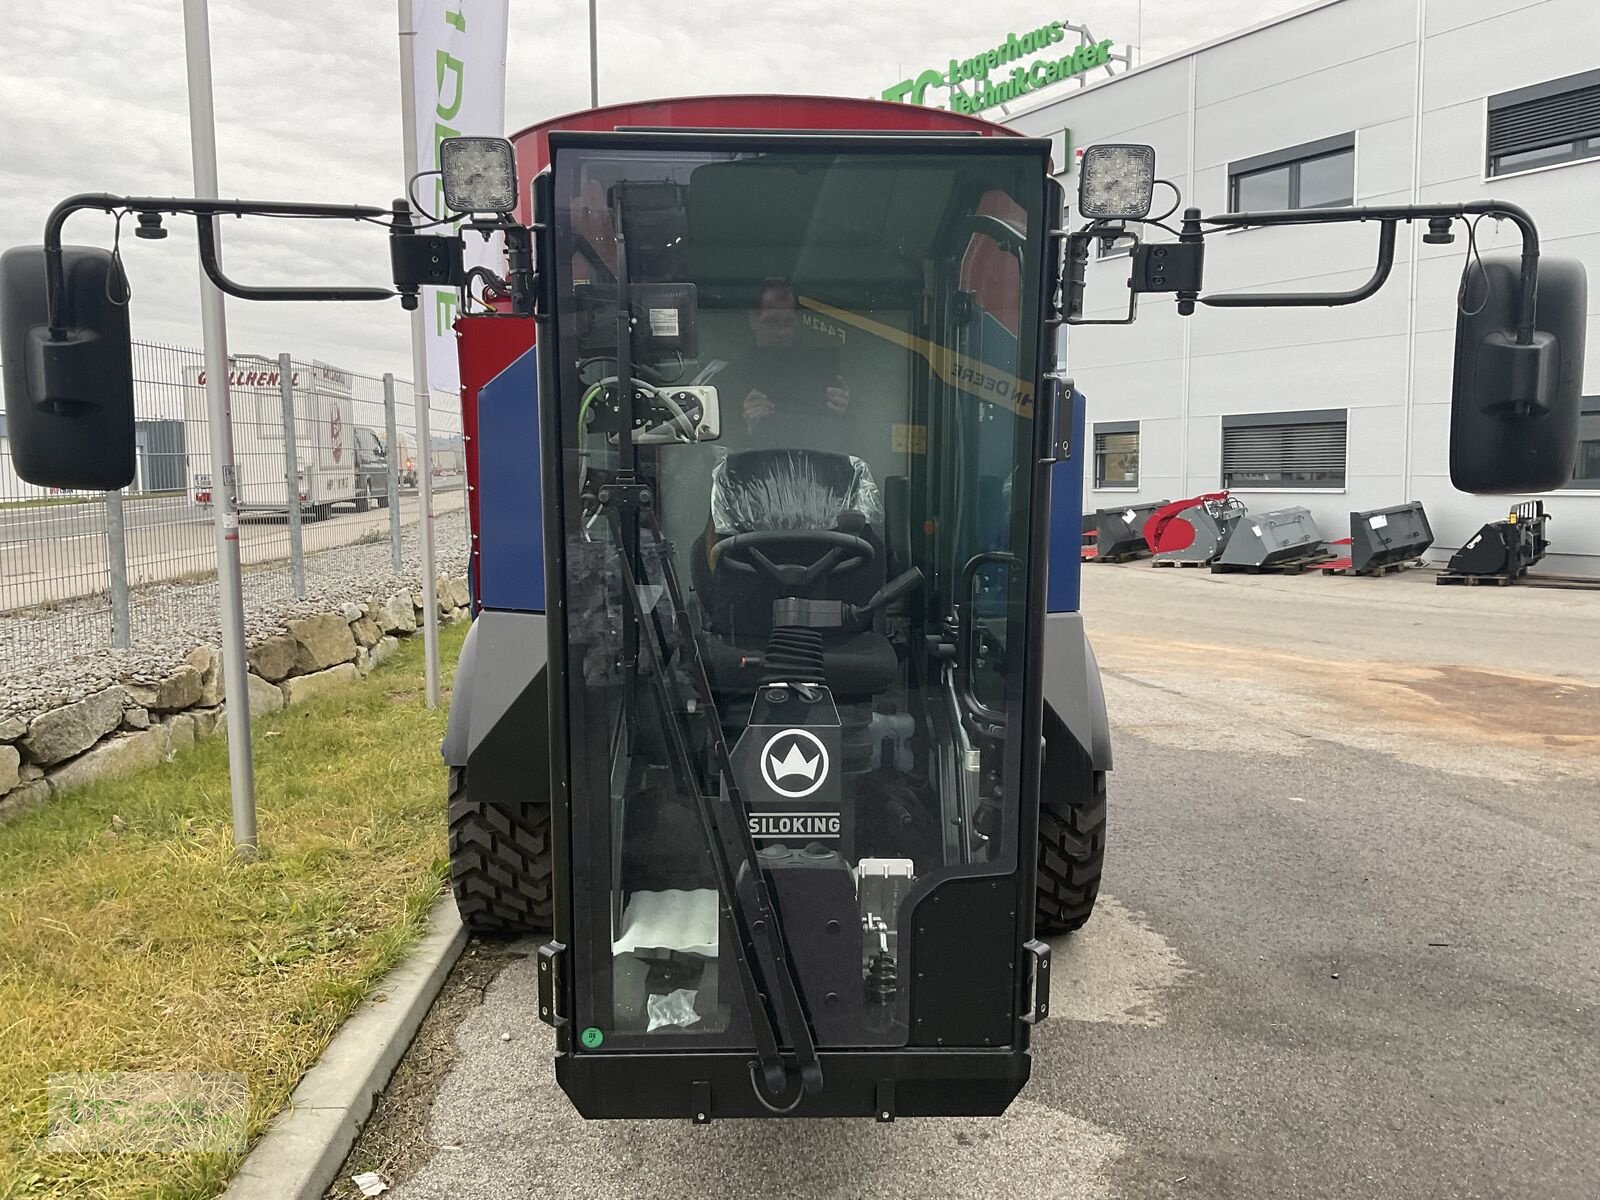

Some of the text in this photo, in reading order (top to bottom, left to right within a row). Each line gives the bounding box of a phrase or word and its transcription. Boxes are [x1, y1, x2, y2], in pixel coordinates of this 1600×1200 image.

[949, 21, 1064, 86] Lagerhaus
[949, 39, 1114, 114] TechnikCenter
[748, 817, 841, 834] SILOKING
